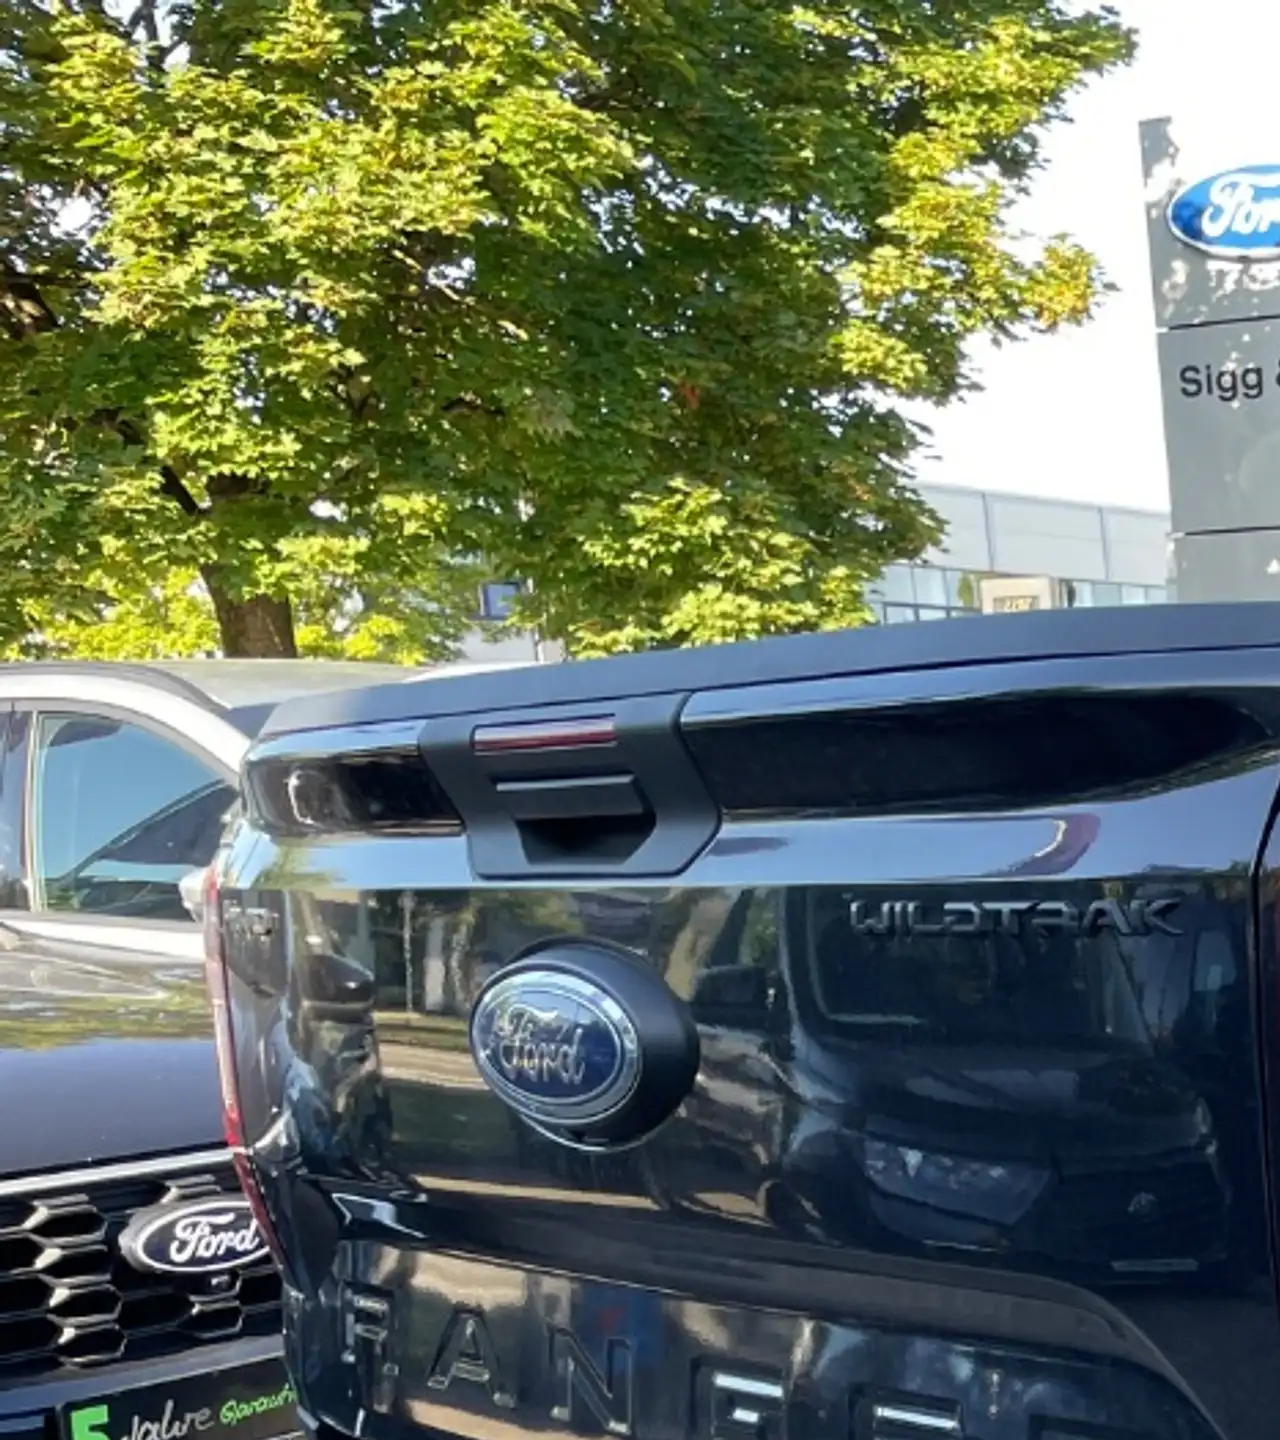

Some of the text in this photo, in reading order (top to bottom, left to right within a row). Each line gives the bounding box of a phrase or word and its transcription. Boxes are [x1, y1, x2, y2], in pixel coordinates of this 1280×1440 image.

[1180, 363, 1263, 401] Sigg
[850, 898, 1184, 934] WILDTRAK
[494, 1004, 586, 1083] Ford
[170, 1212, 260, 1263] Ford
